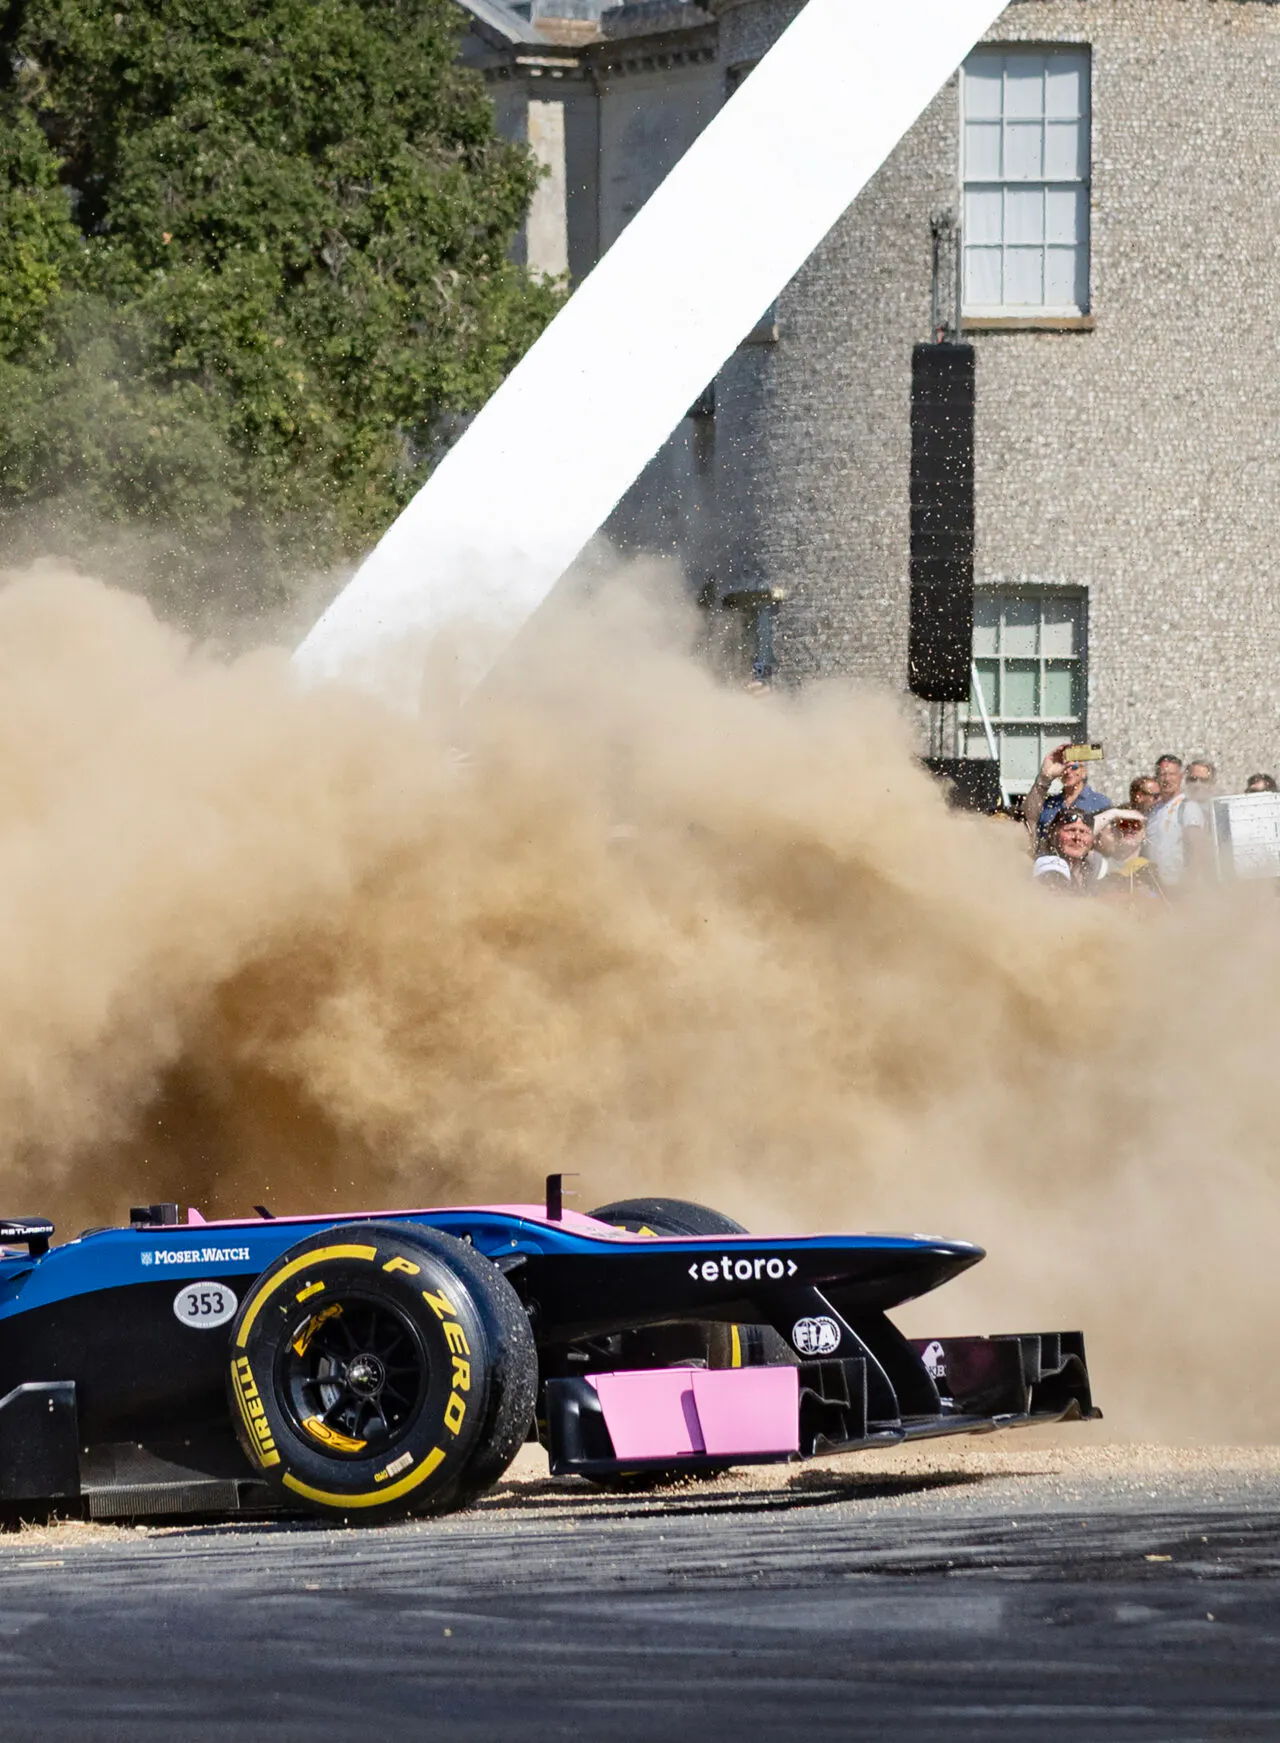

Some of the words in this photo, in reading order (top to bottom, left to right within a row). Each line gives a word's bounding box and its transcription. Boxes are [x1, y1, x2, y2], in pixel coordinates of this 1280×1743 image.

[187, 1292, 224, 1316] 353
[382, 1257, 421, 1275] P
[422, 1289, 470, 1435] ZERO
[231, 1356, 280, 1468] PIRELLI
